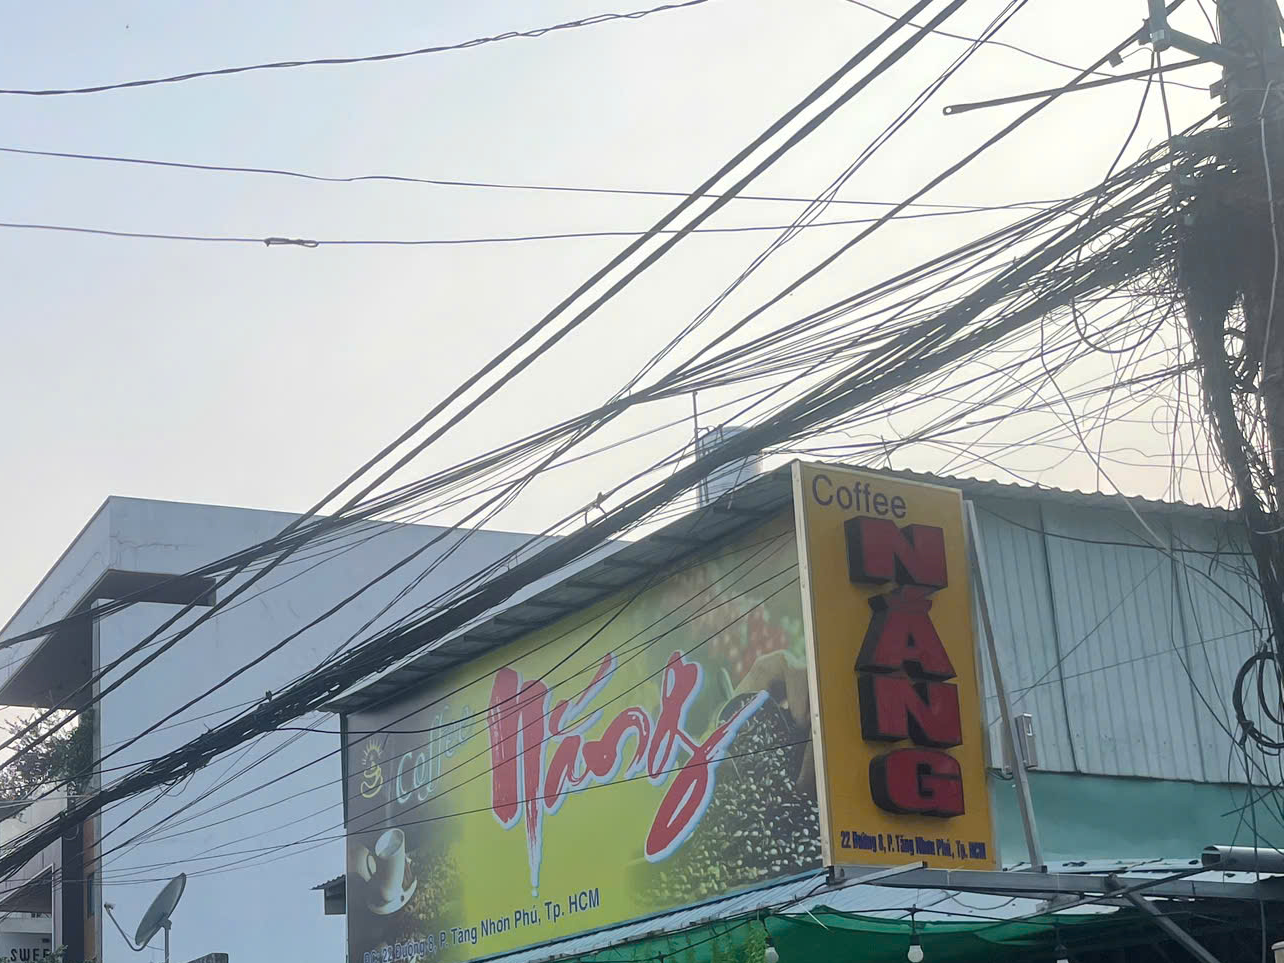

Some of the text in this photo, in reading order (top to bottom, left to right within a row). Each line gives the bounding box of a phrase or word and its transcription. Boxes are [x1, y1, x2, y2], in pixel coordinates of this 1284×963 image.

[812, 474, 907, 519] Coffee
[486, 649, 771, 898] Nắng
[545, 900, 565, 922] Tp.
[568, 888, 600, 914] HCM
